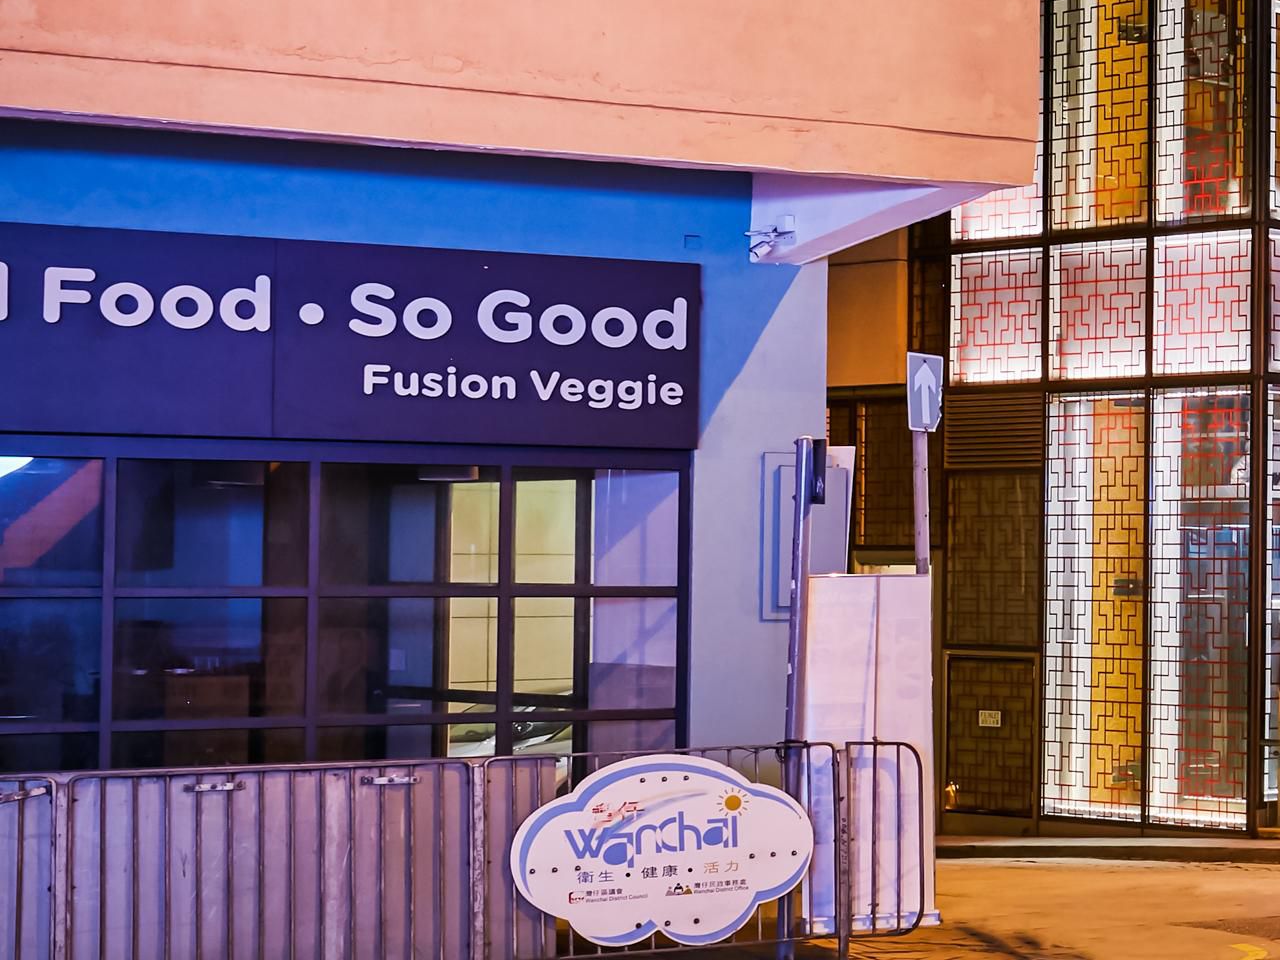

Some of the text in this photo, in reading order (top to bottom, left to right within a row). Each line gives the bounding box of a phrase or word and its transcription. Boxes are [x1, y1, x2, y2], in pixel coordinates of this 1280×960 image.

[43, 266, 271, 332] Food
[348, 282, 452, 340] So
[477, 289, 688, 350] Good
[363, 364, 684, 410] Fusion Veggie
[576, 860, 740, 884] 衛生 健康 活力
[609, 894, 627, 902] District
